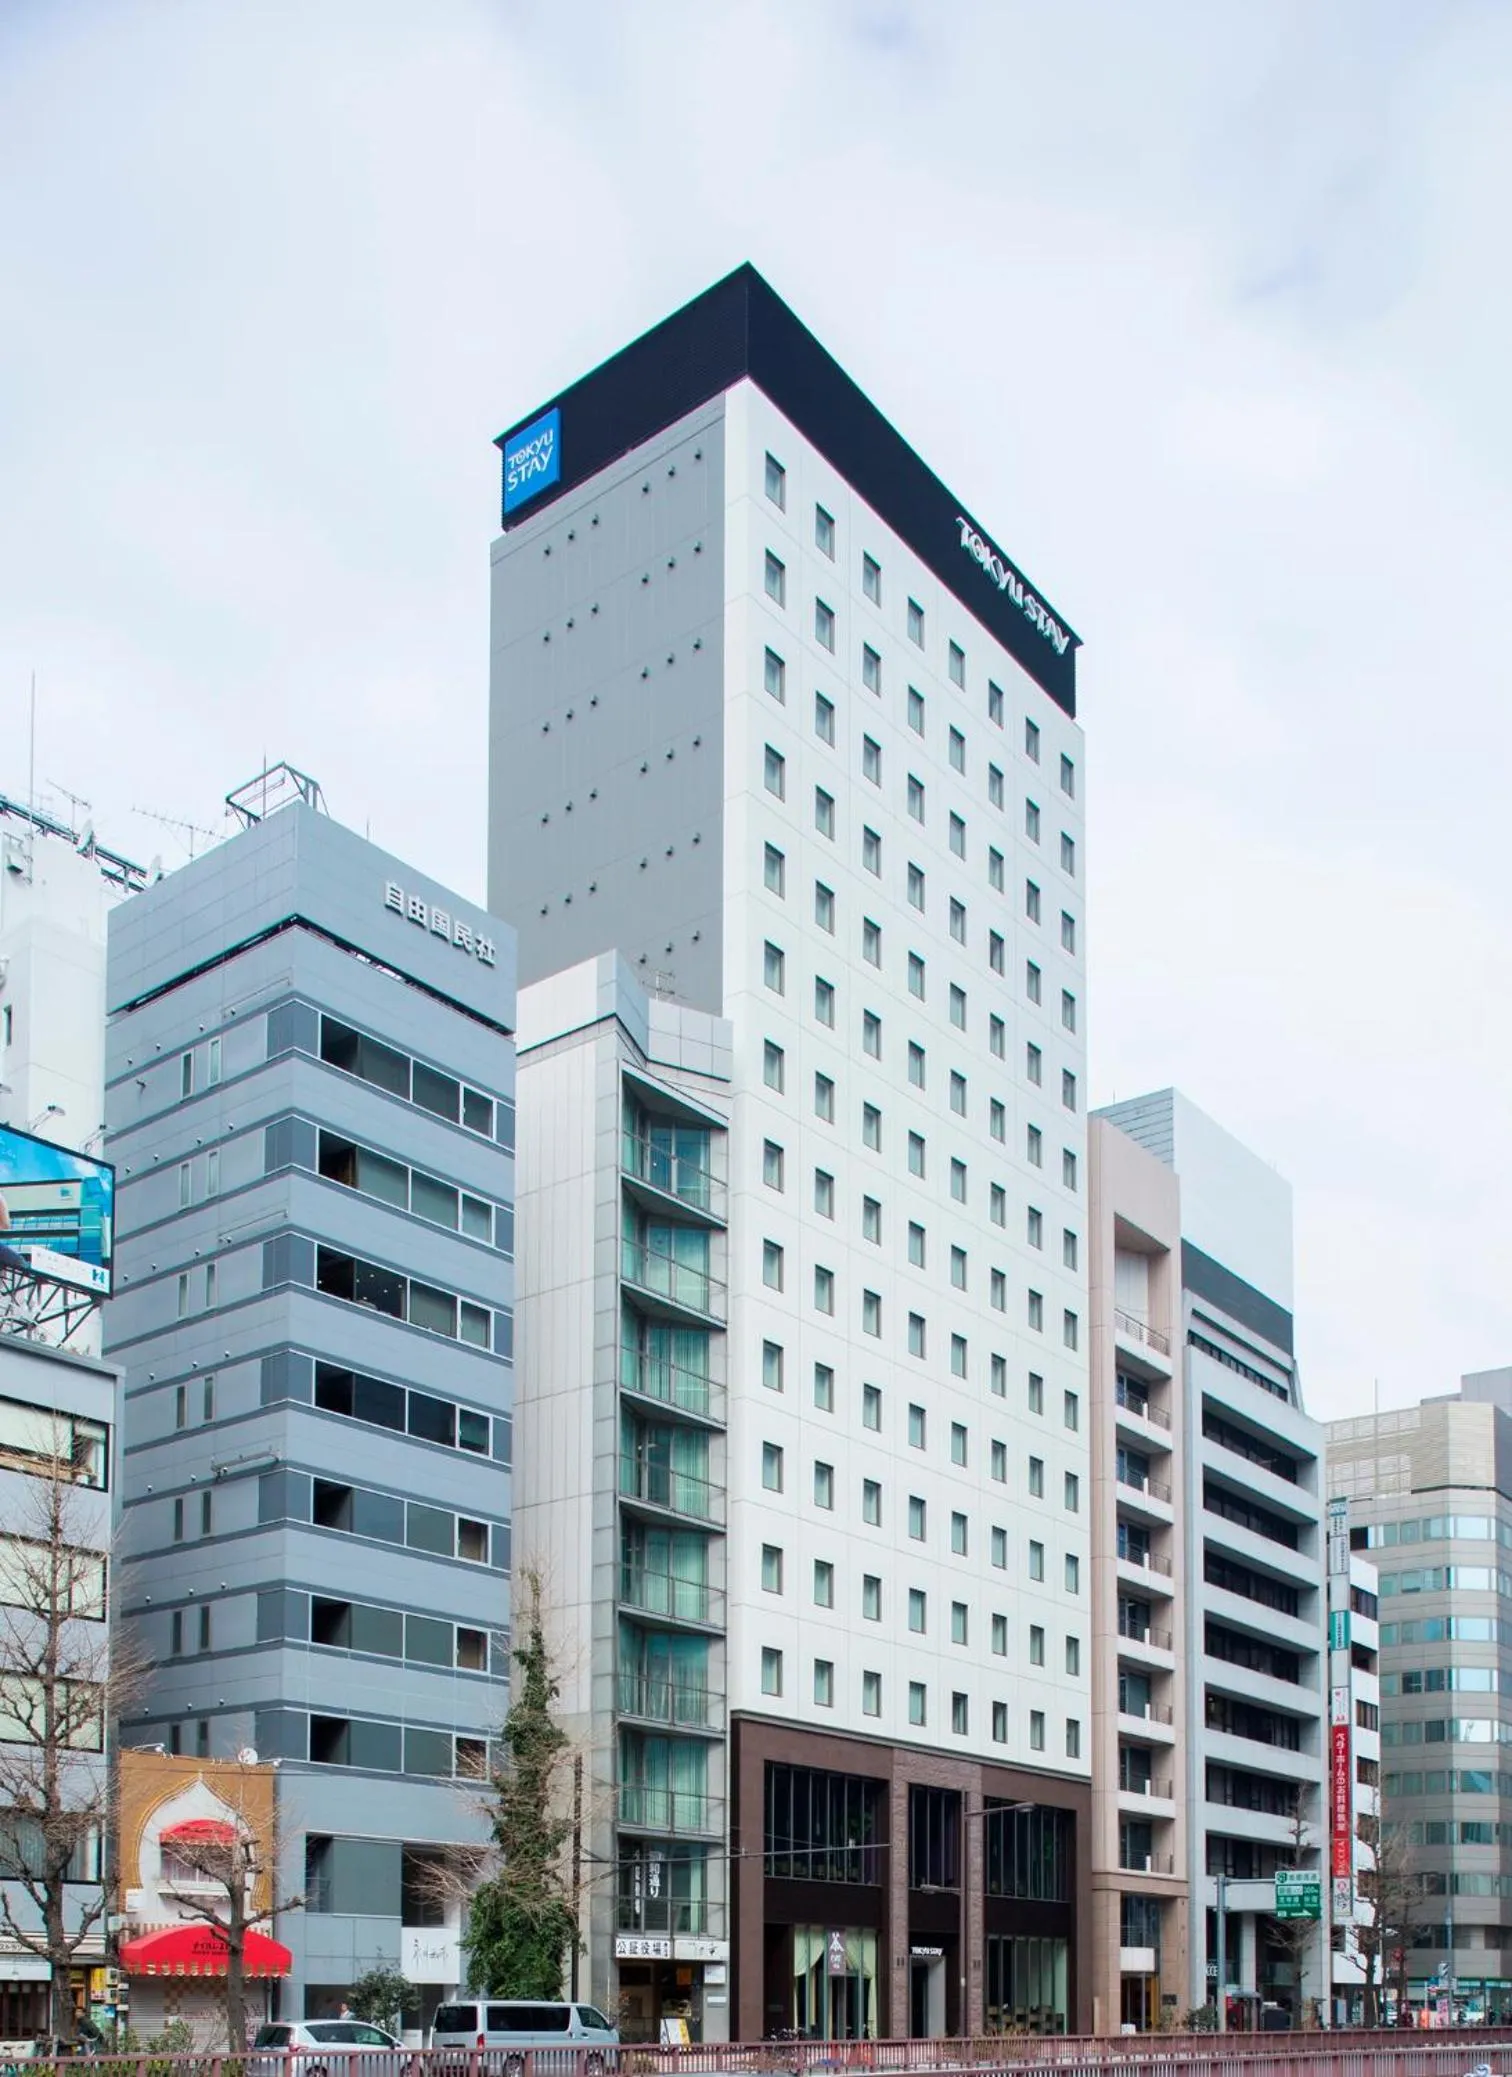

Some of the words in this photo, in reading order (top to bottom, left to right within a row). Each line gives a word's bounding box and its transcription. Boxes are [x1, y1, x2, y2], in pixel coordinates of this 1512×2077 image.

[508, 429, 554, 469] TOKYU
[508, 445, 554, 492] STAY
[956, 516, 1024, 609] TOKYU
[1024, 594, 1070, 656] STAY
[384, 881, 497, 967] 自由国民社
